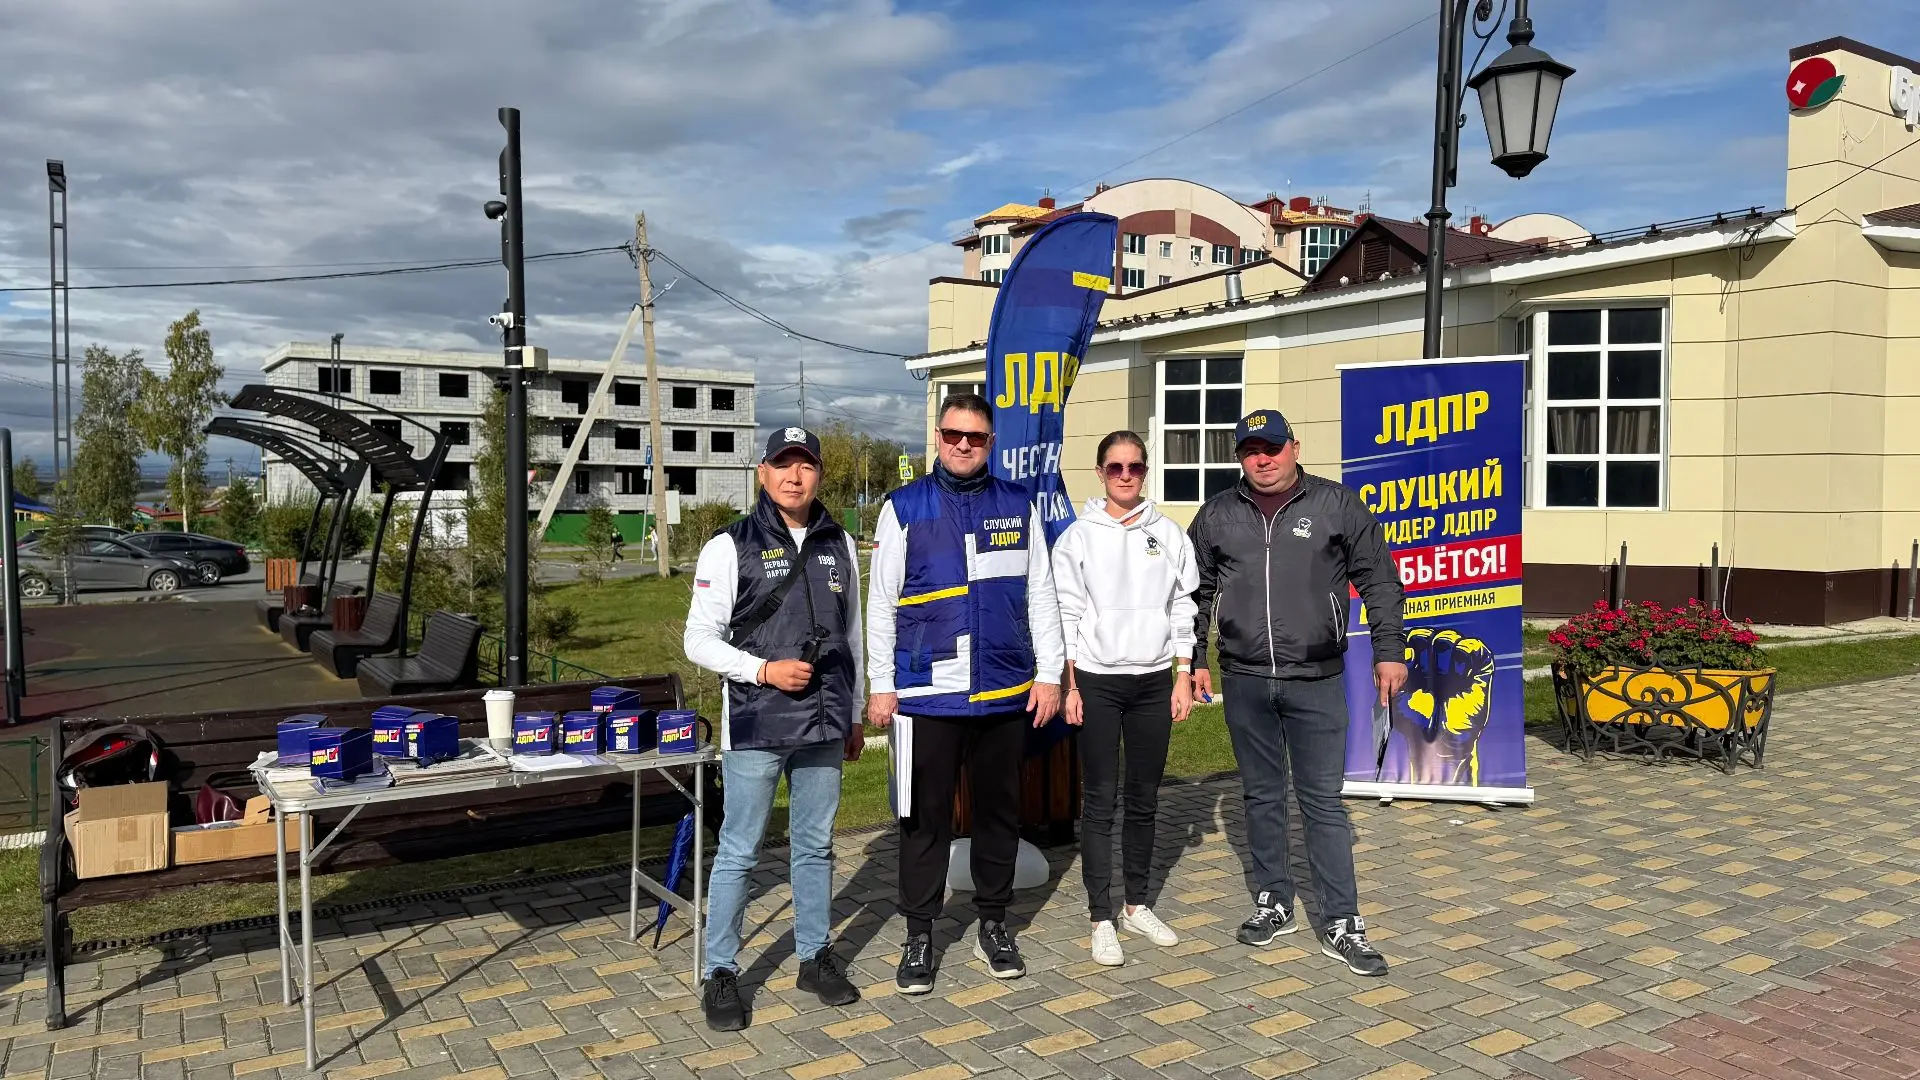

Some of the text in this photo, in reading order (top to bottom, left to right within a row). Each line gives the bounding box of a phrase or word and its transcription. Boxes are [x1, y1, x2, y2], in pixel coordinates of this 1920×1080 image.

[995, 351, 1080, 414] ЛДР
[1247, 415, 1267, 427] 1989
[1374, 390, 1490, 447] ЛДПР
[1359, 458, 1503, 514] СЛУЦКИЙ
[983, 515, 1023, 531] СЛУЦКИЙ
[1380, 509, 1498, 545] ИДЕР ЛДПР
[989, 531, 1021, 547] ЛДПР
[761, 547, 785, 560] ЛДПР
[818, 555, 836, 566] 1989
[763, 560, 789, 570] ПЕРВАЯ
[1399, 543, 1507, 586] БЬЁТСЯ!
[1435, 592, 1496, 611] ПРИЕМНАЯ
